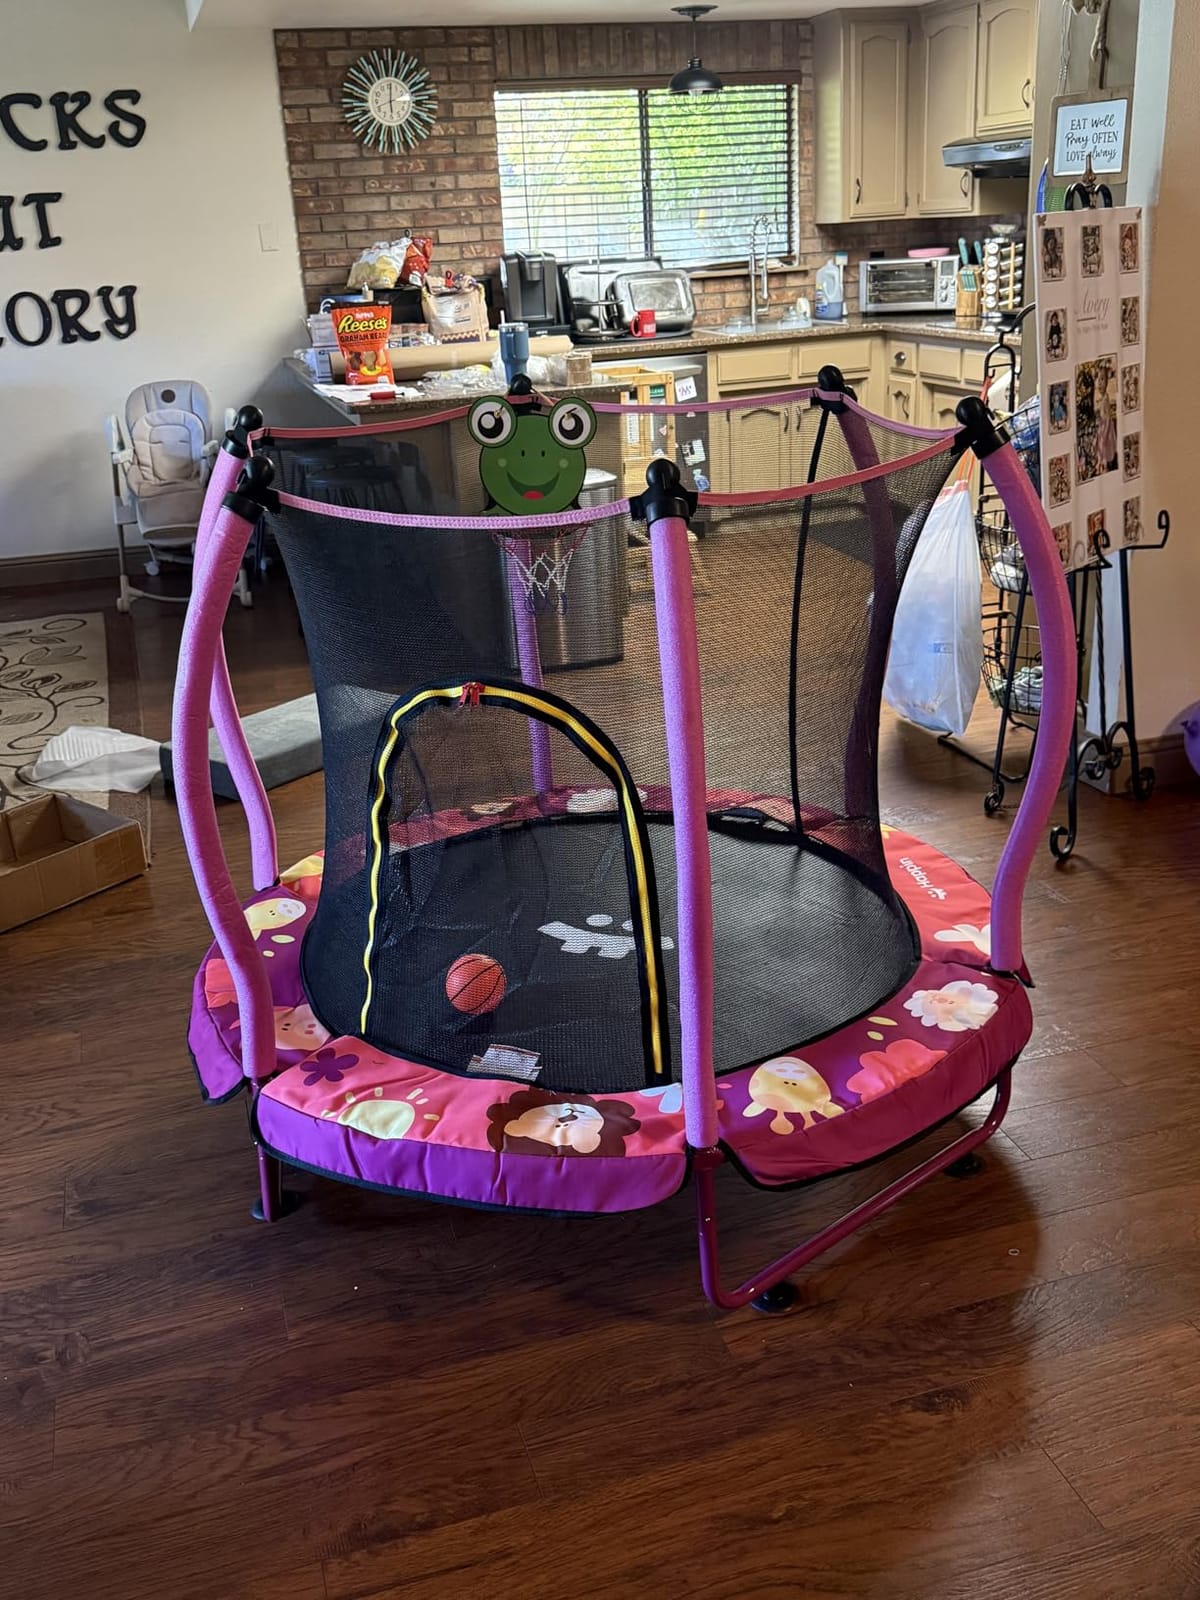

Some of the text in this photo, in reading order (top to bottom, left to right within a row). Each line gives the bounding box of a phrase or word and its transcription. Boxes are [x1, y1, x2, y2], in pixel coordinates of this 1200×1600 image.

[1070, 118, 1088, 131] EAT
[1065, 131, 1119, 149] Pray OFTEN
[1066, 145, 1117, 163] LOVE lways
[0, 285, 137, 347] ORY
[338, 315, 387, 333] Reese's
